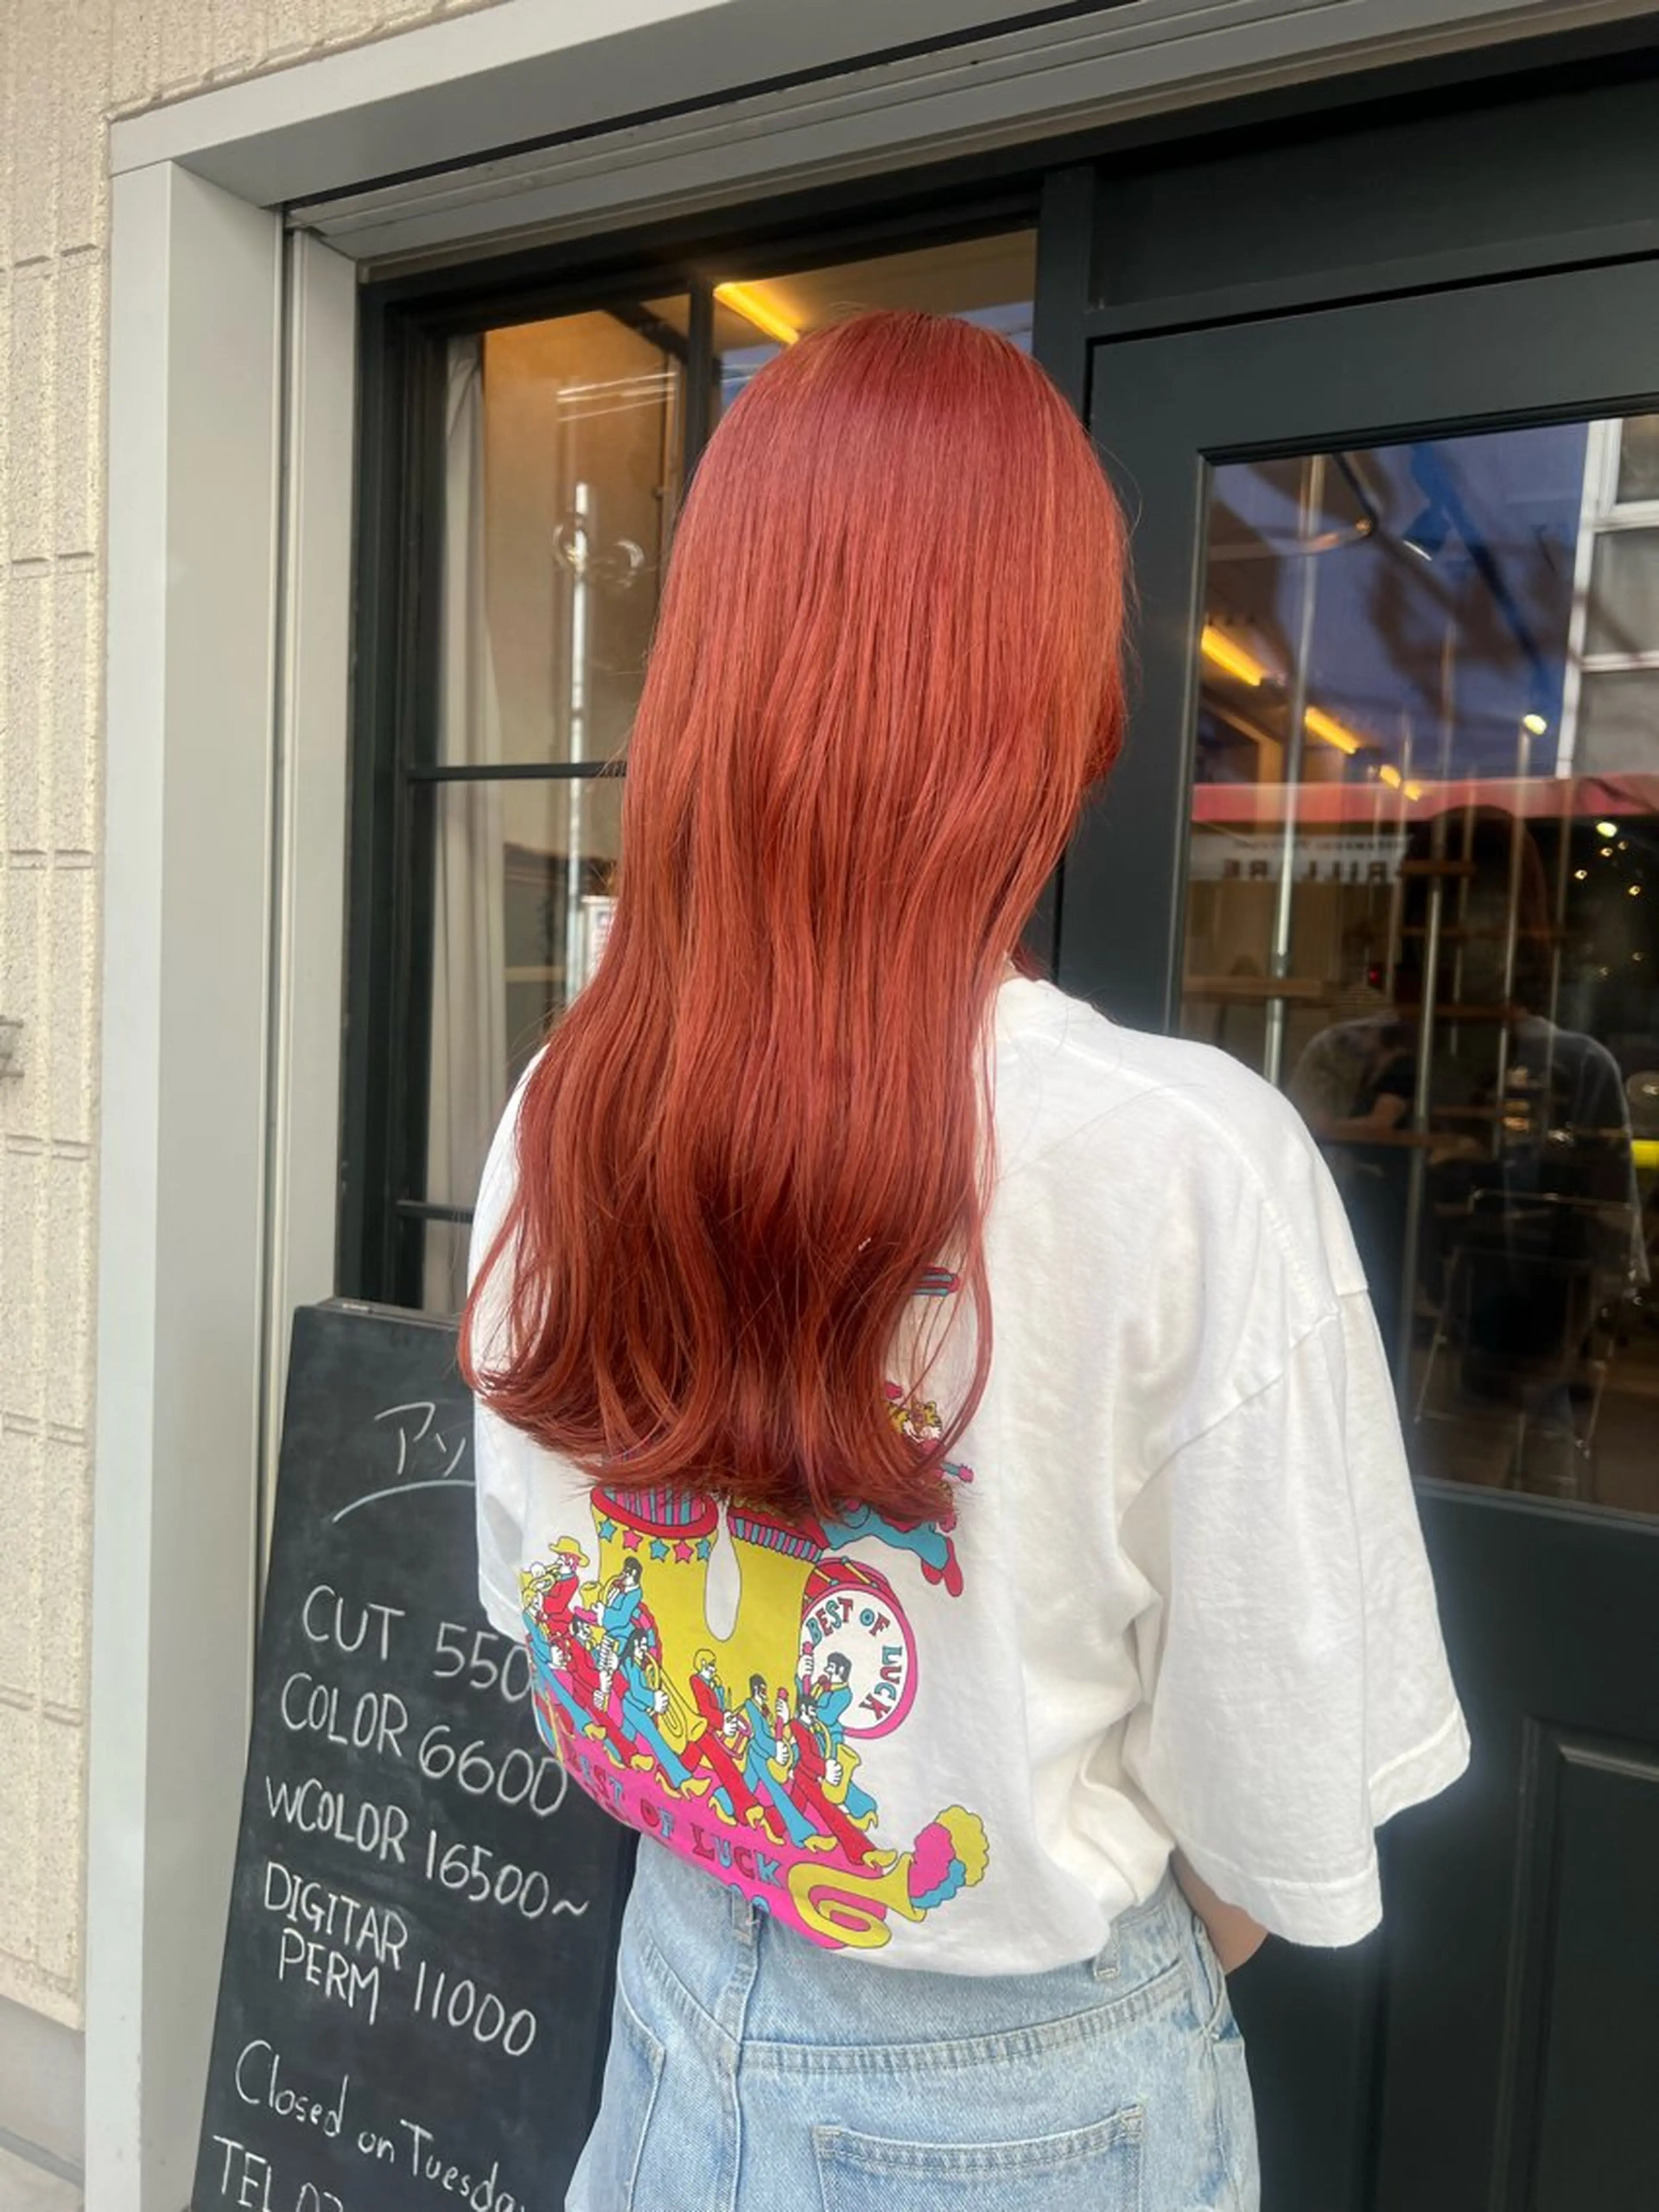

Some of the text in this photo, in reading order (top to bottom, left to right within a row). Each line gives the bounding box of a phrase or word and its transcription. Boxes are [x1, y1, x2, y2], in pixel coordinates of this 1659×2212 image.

[303, 1585, 405, 1661] CUT
[806, 1597, 903, 1721] BEST OF LUCK
[281, 1673, 568, 1815] COLOR 6600
[265, 1776, 409, 1863] WCOLOR
[640, 1798, 674, 1840] OF
[690, 1821, 785, 1890] LUCK
[264, 1862, 408, 1970] DIGITAR
[279, 1929, 536, 2056] PERM 11000
[213, 2135, 272, 2212] TEL
[235, 2040, 526, 2212] Closed on Tuesda
